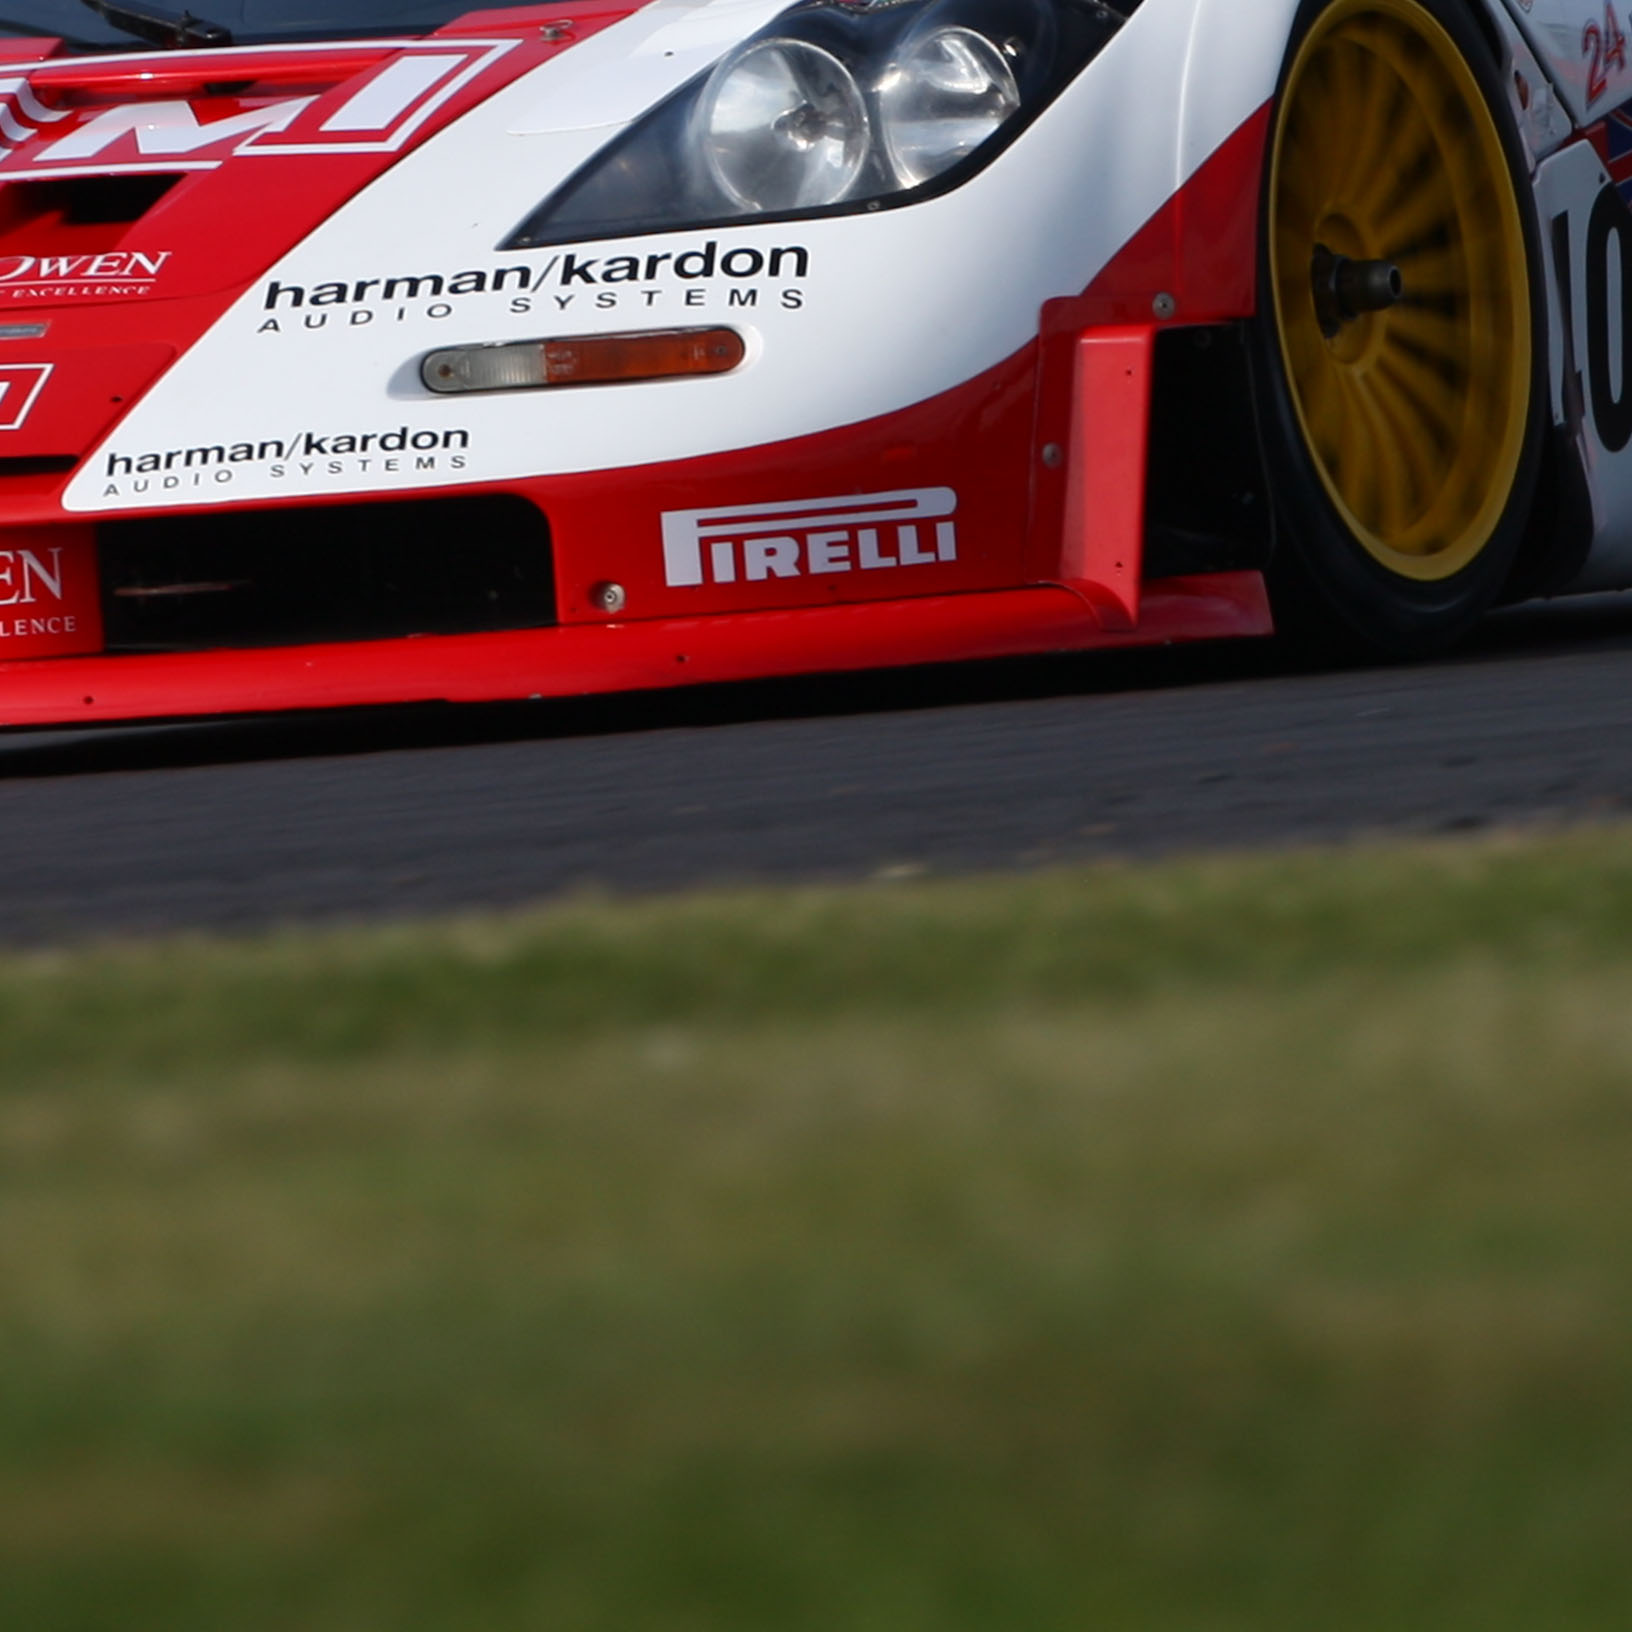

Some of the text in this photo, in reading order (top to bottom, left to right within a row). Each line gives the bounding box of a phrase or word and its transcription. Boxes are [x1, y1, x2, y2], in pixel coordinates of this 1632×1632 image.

[11, 285, 152, 299] EXCELLENCE
[265, 241, 809, 310] harman/kardon
[257, 287, 807, 335] AUDIO SYSTEMS
[102, 455, 469, 499] AUDIO SYSTEMS
[105, 427, 470, 478] harman/kardon
[660, 486, 958, 587] PIRELLI
